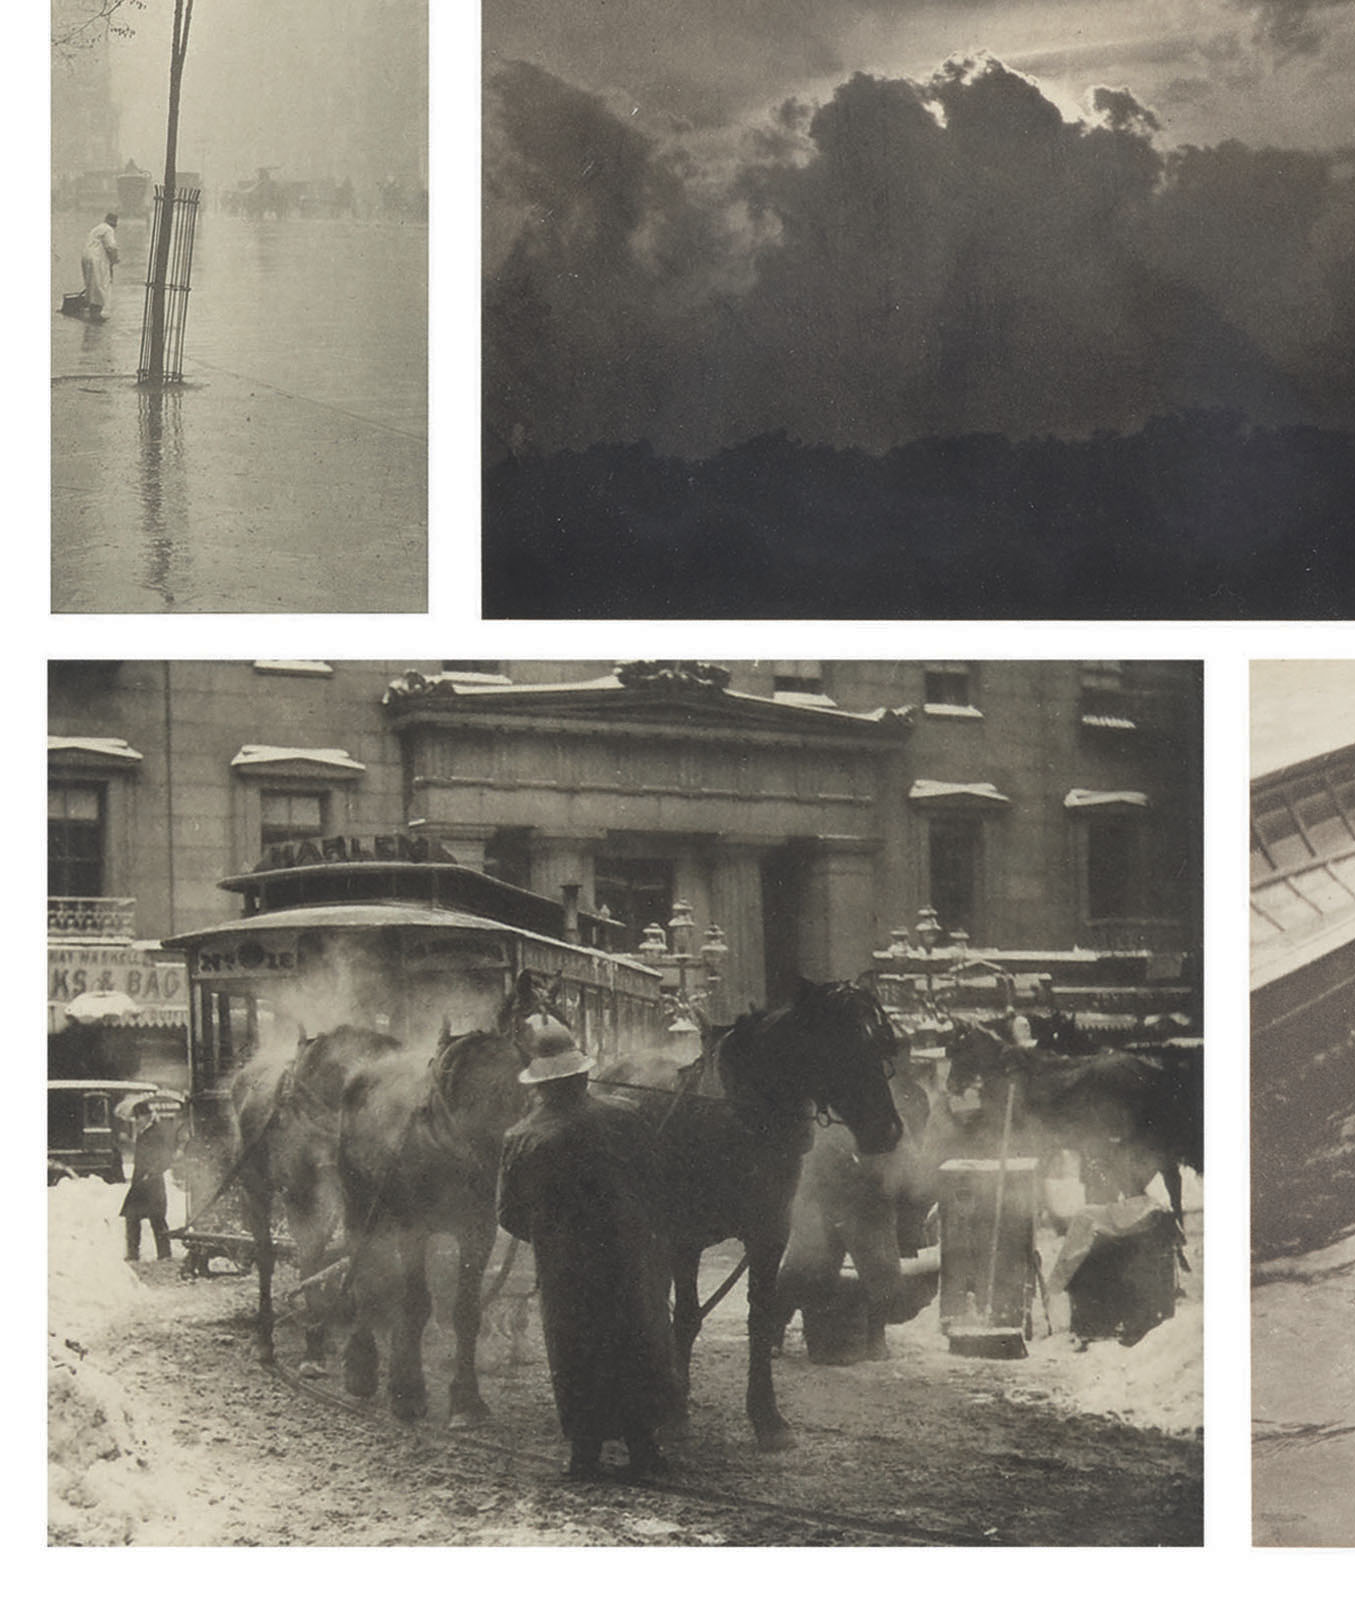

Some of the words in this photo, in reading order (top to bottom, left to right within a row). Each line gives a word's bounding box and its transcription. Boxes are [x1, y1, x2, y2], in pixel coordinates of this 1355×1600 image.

[270, 835, 429, 866] HARLEM
[51, 969, 87, 1000] KS
[127, 970, 181, 999] BAG
